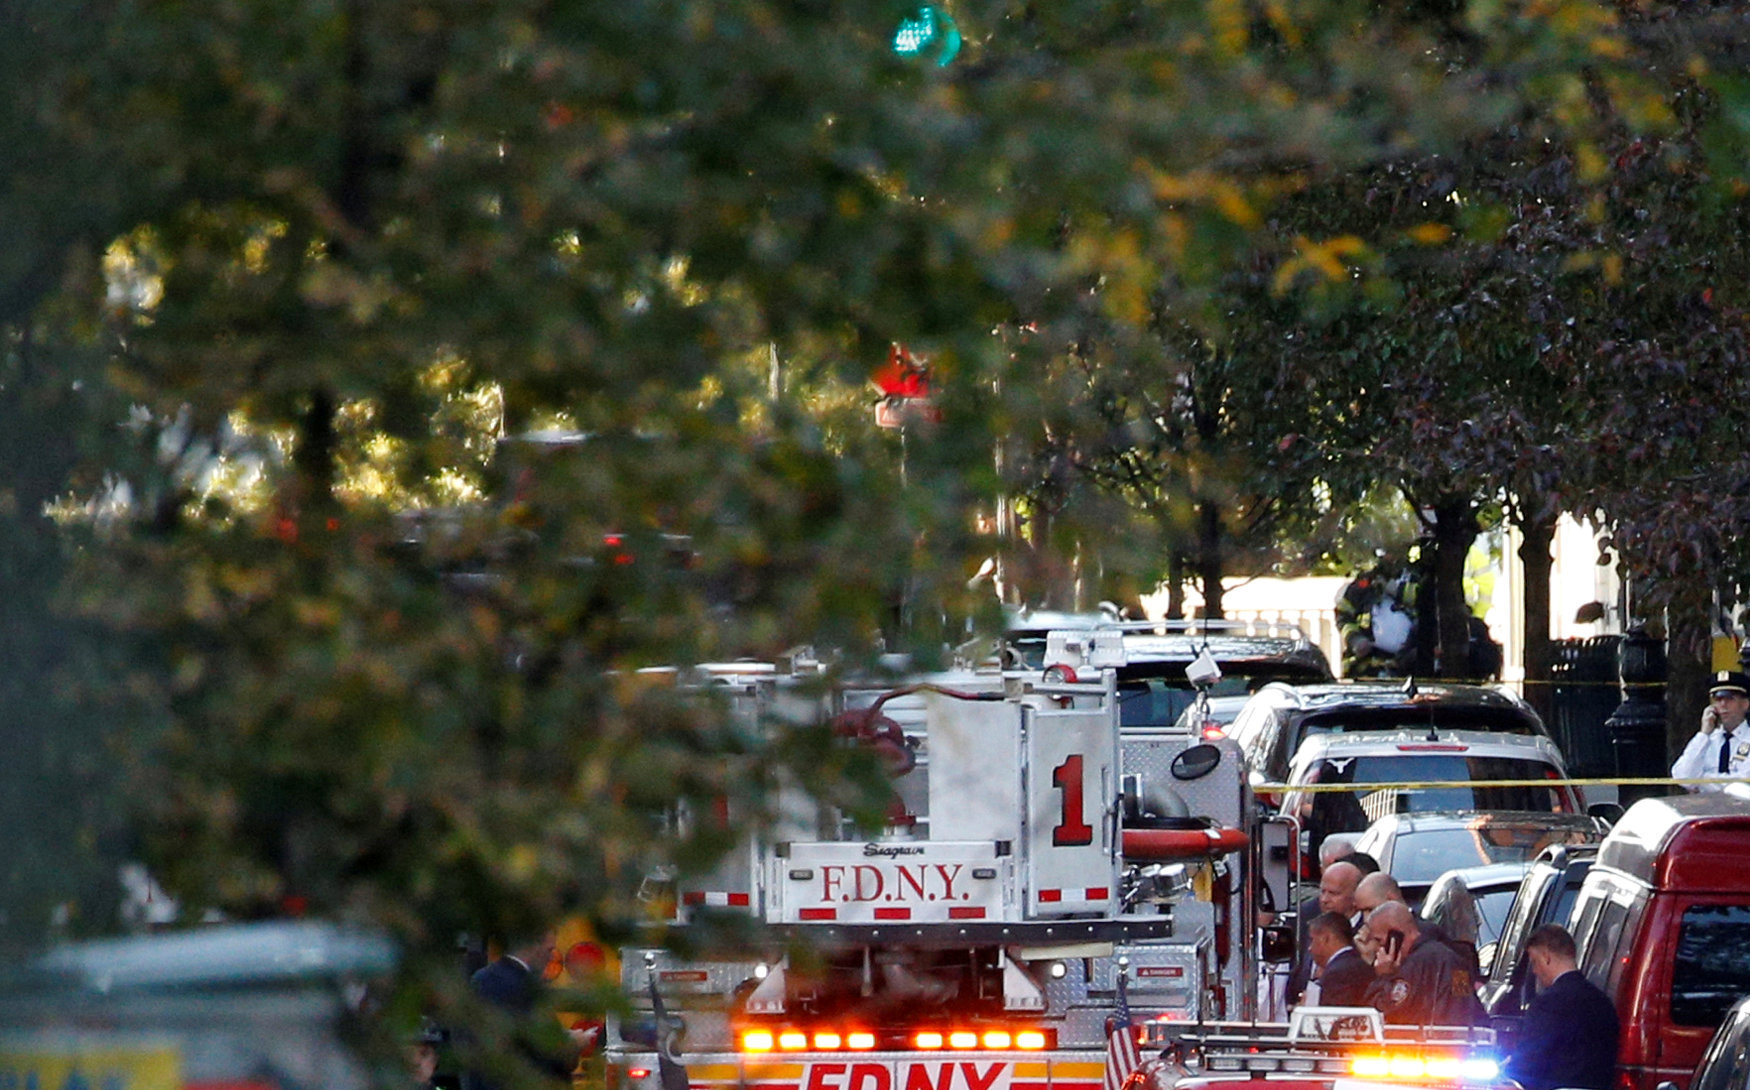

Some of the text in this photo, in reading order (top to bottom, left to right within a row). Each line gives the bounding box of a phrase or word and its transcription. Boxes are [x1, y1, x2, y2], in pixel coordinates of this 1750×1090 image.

[1053, 754, 1093, 847] 1
[863, 842, 925, 859] Seagrave
[820, 864, 969, 902] F.D.N.Y.
